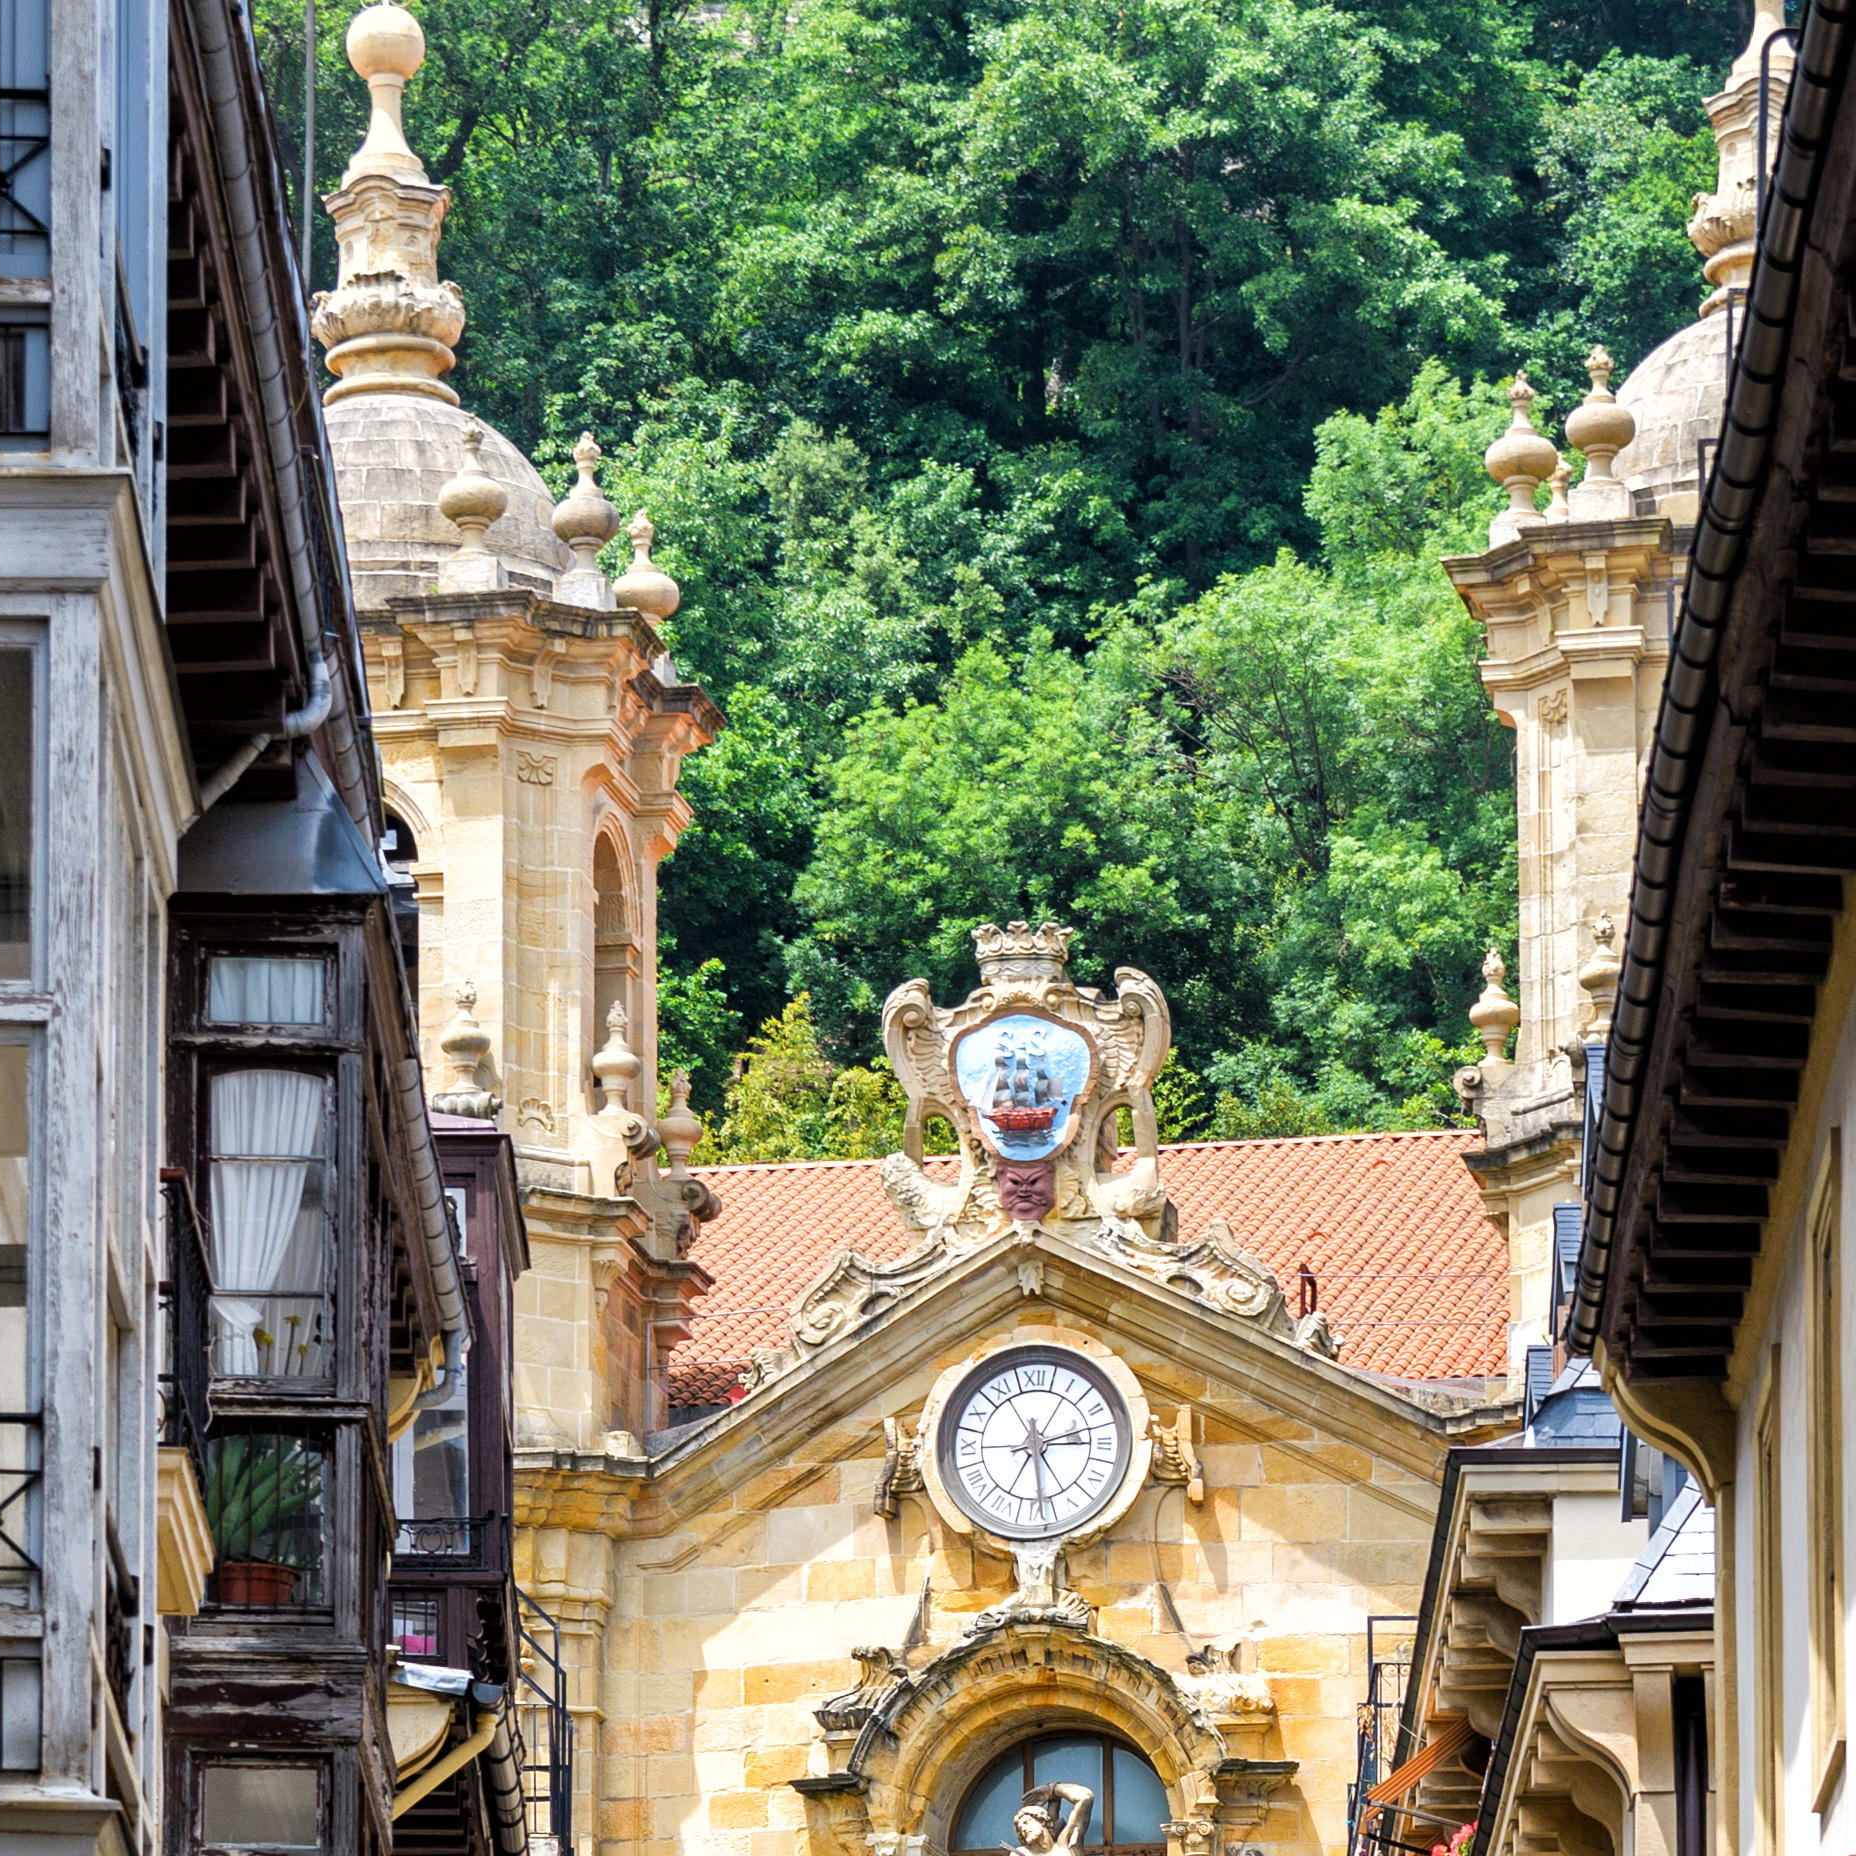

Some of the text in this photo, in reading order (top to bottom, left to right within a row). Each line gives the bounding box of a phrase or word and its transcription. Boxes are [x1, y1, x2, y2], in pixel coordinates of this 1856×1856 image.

[1023, 1370, 1046, 1387] XII
[1065, 1378, 1075, 1393] I
[990, 1378, 1011, 1400] XI
[968, 1405, 987, 1423] X
[1087, 1403, 1104, 1416] II
[960, 1438, 977, 1456] IX
[1097, 1437, 1112, 1451] III
[966, 1469, 987, 1497] VIII
[991, 1495, 1012, 1517] VII
